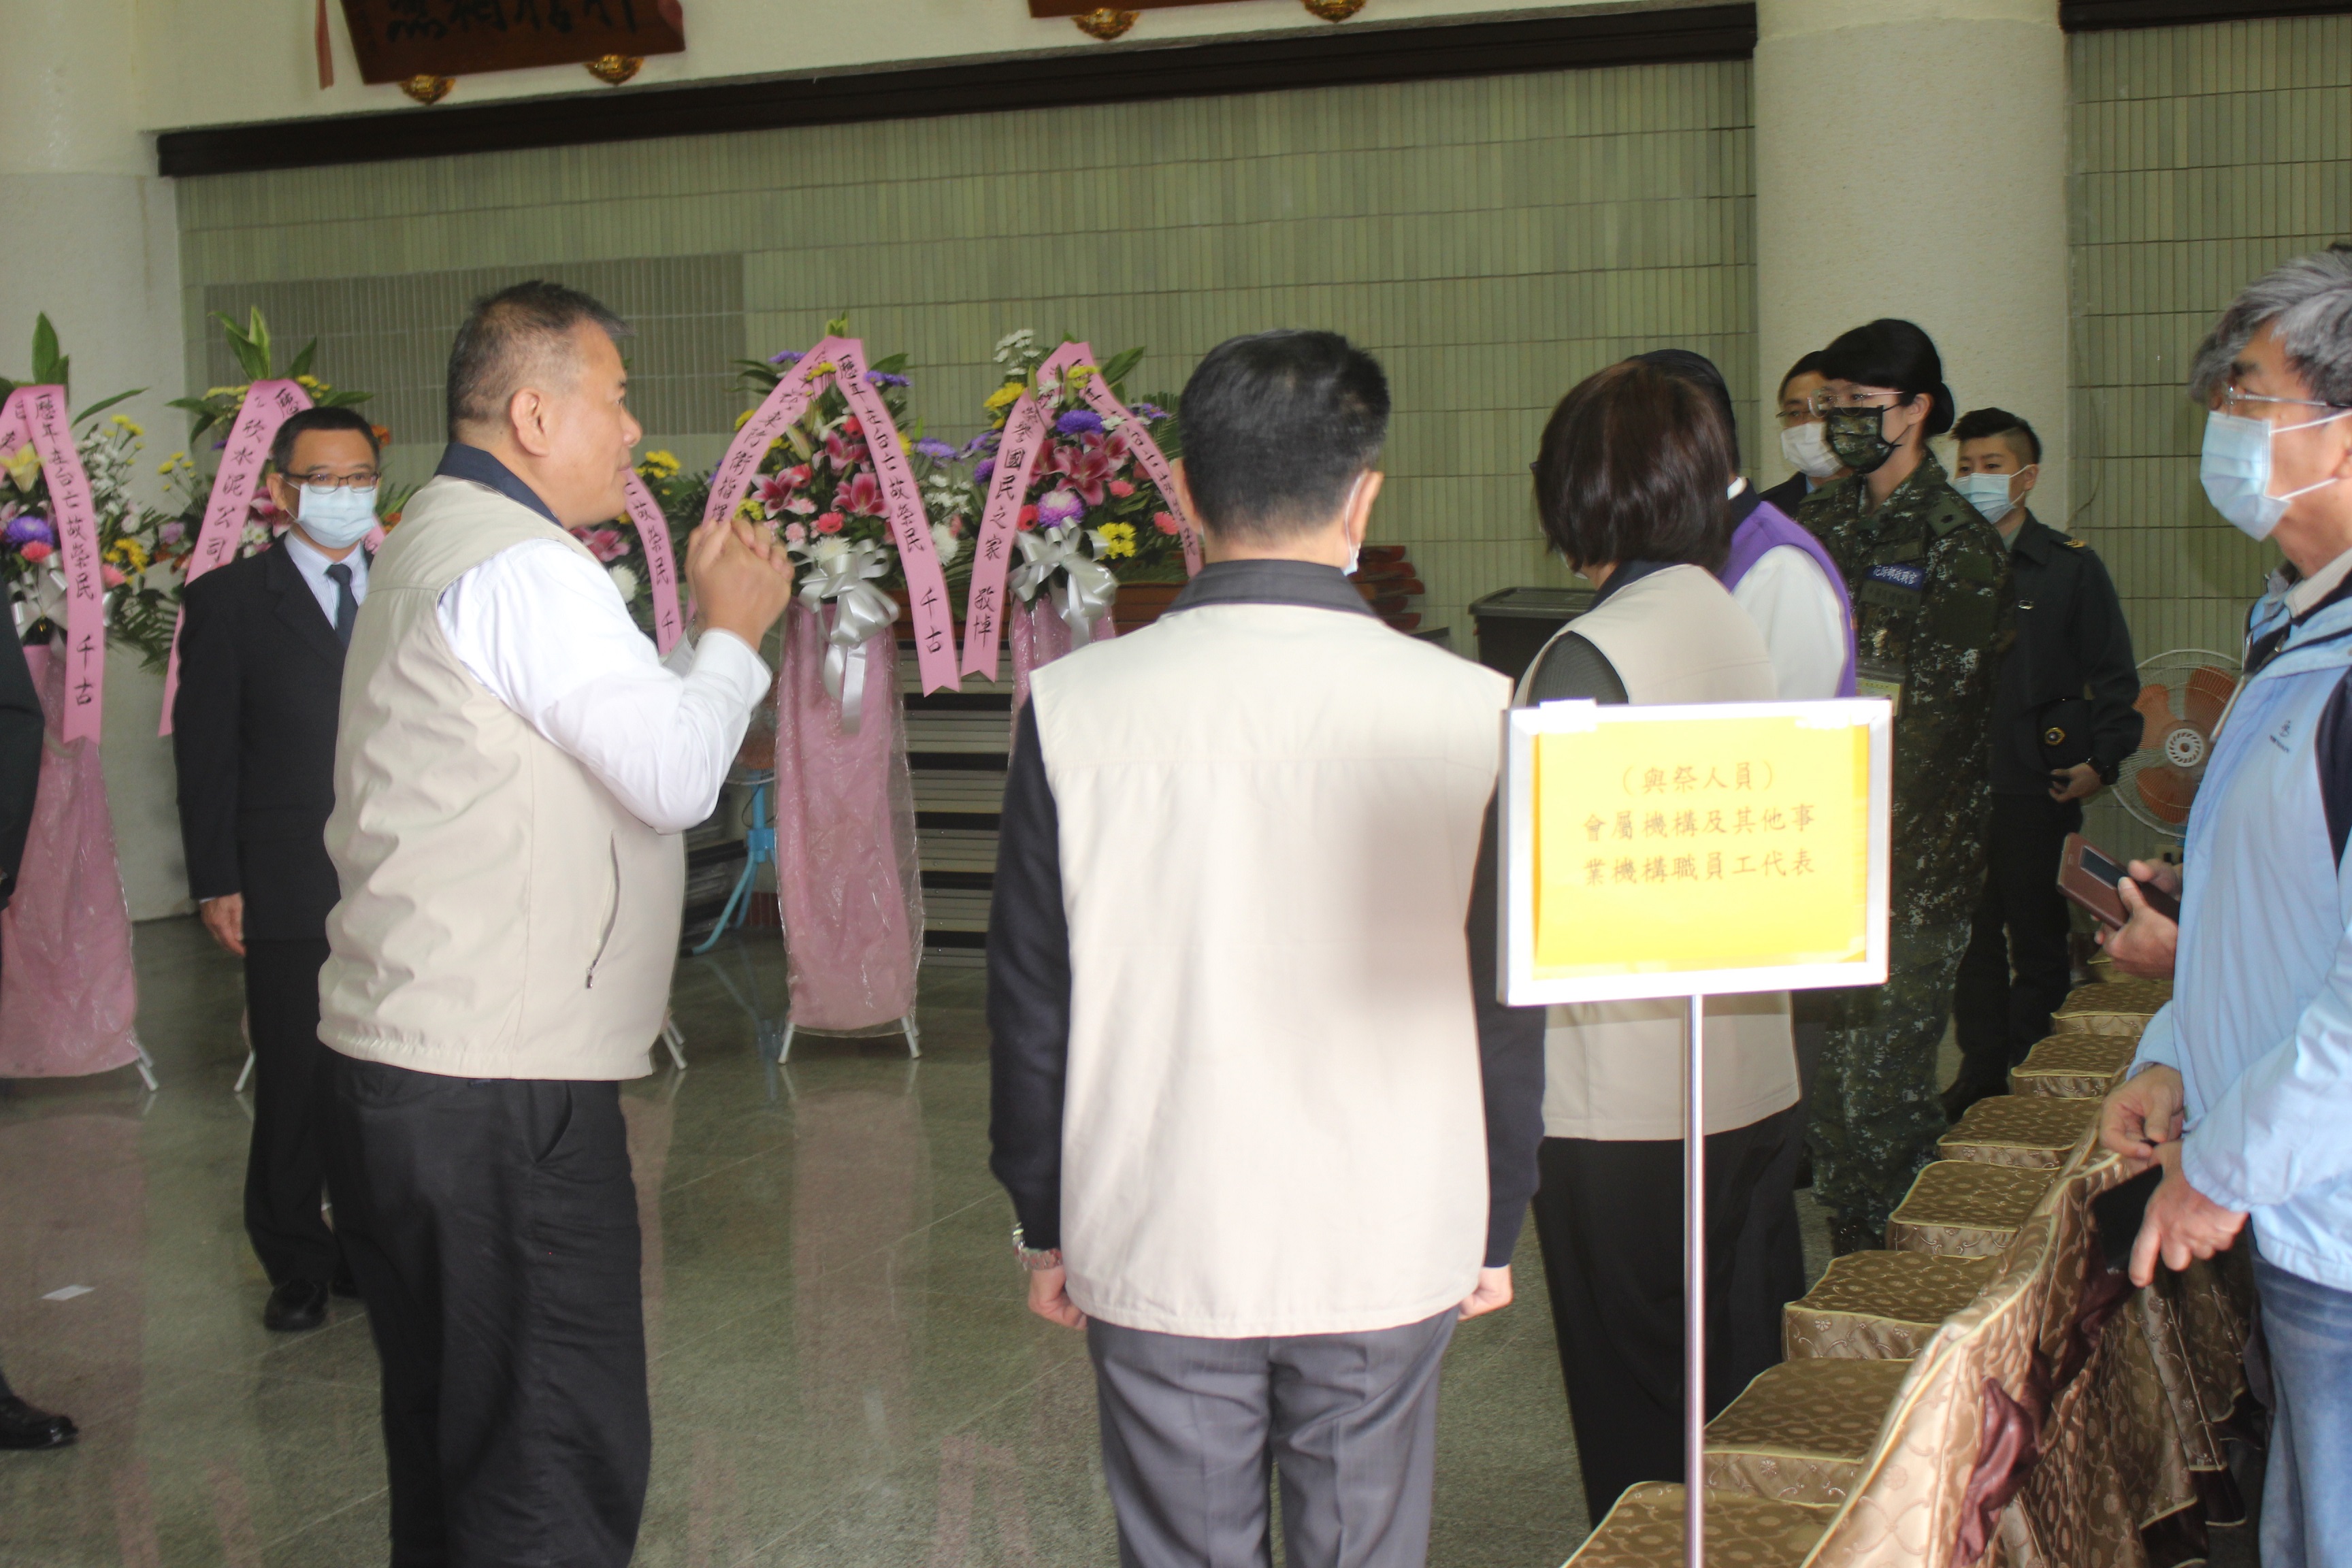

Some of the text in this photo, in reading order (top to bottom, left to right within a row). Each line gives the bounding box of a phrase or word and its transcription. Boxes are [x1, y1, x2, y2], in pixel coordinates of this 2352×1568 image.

[919, 587, 943, 654] 千古
[75, 634, 93, 706] 千古
[1583, 803, 1816, 843] 會屬機構及其他事
[1583, 848, 1816, 887] 業機構職員工代表
